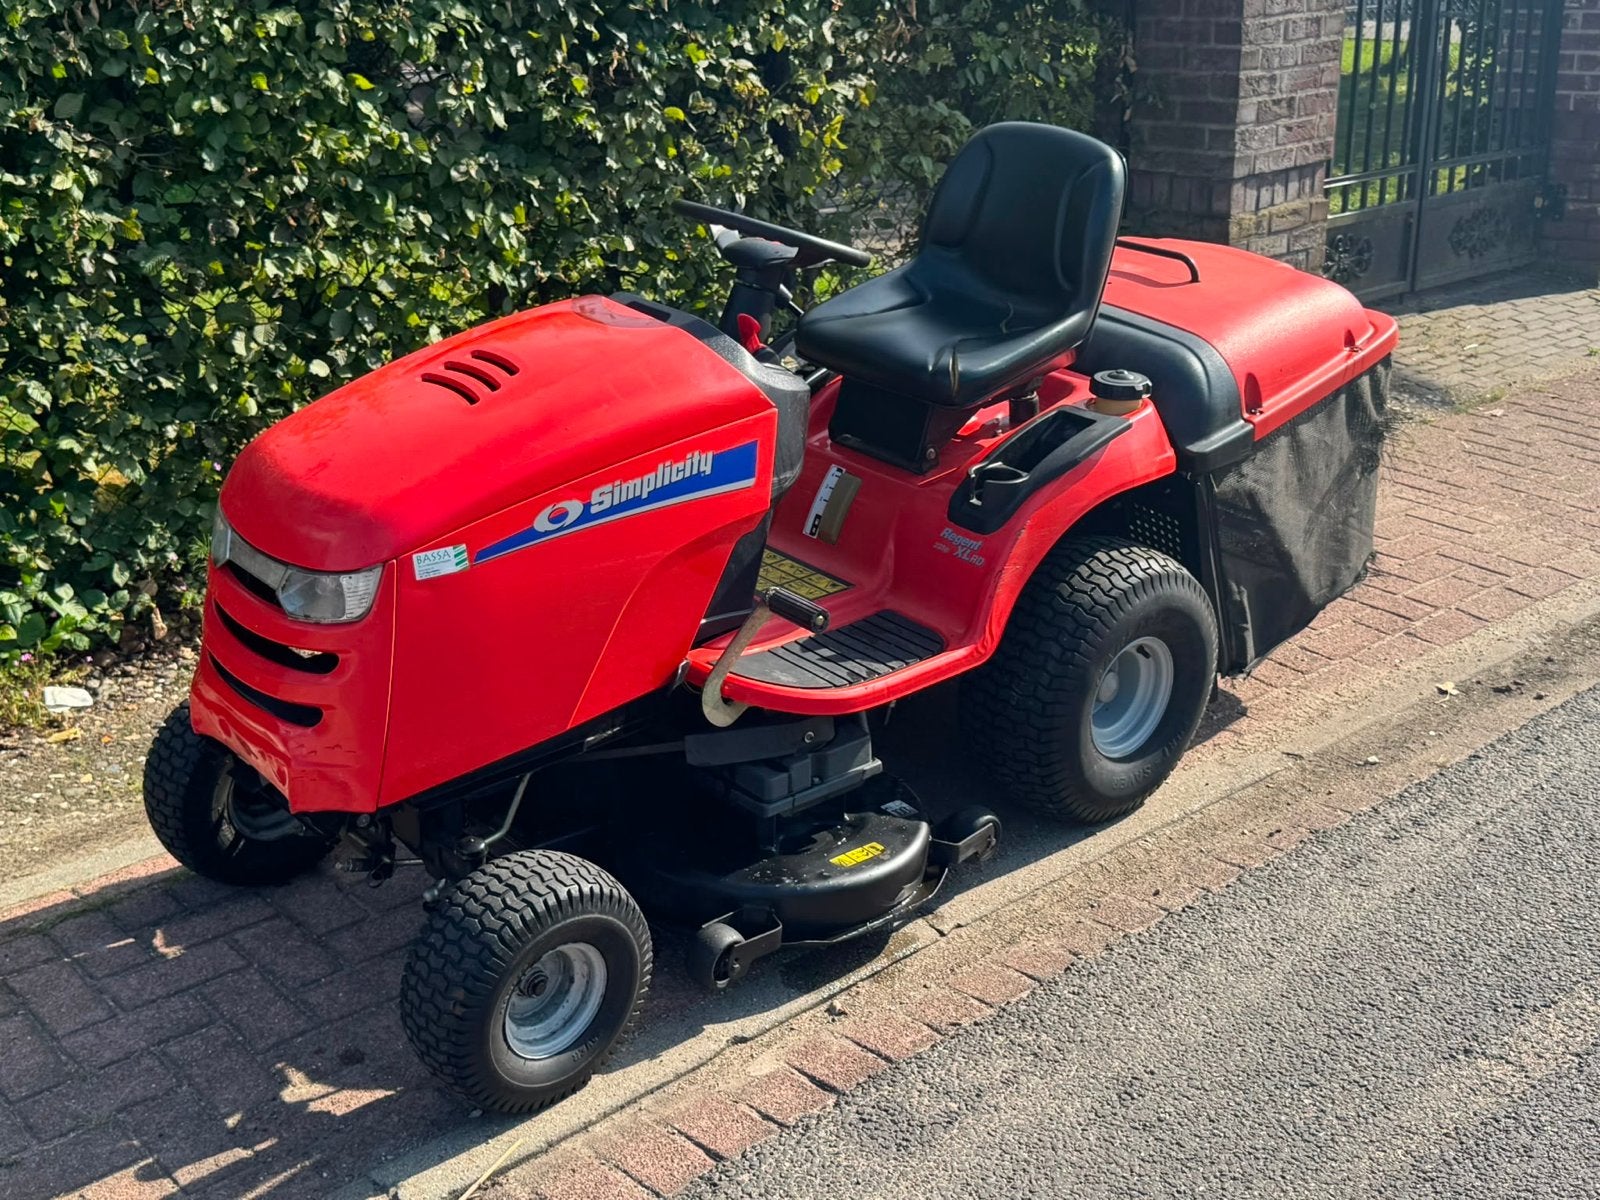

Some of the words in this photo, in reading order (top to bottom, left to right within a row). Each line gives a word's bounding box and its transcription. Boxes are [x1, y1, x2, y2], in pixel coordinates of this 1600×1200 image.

[590, 450, 714, 514] Simplicity
[940, 528, 983, 550] Regent
[416, 549, 451, 565] BASSA
